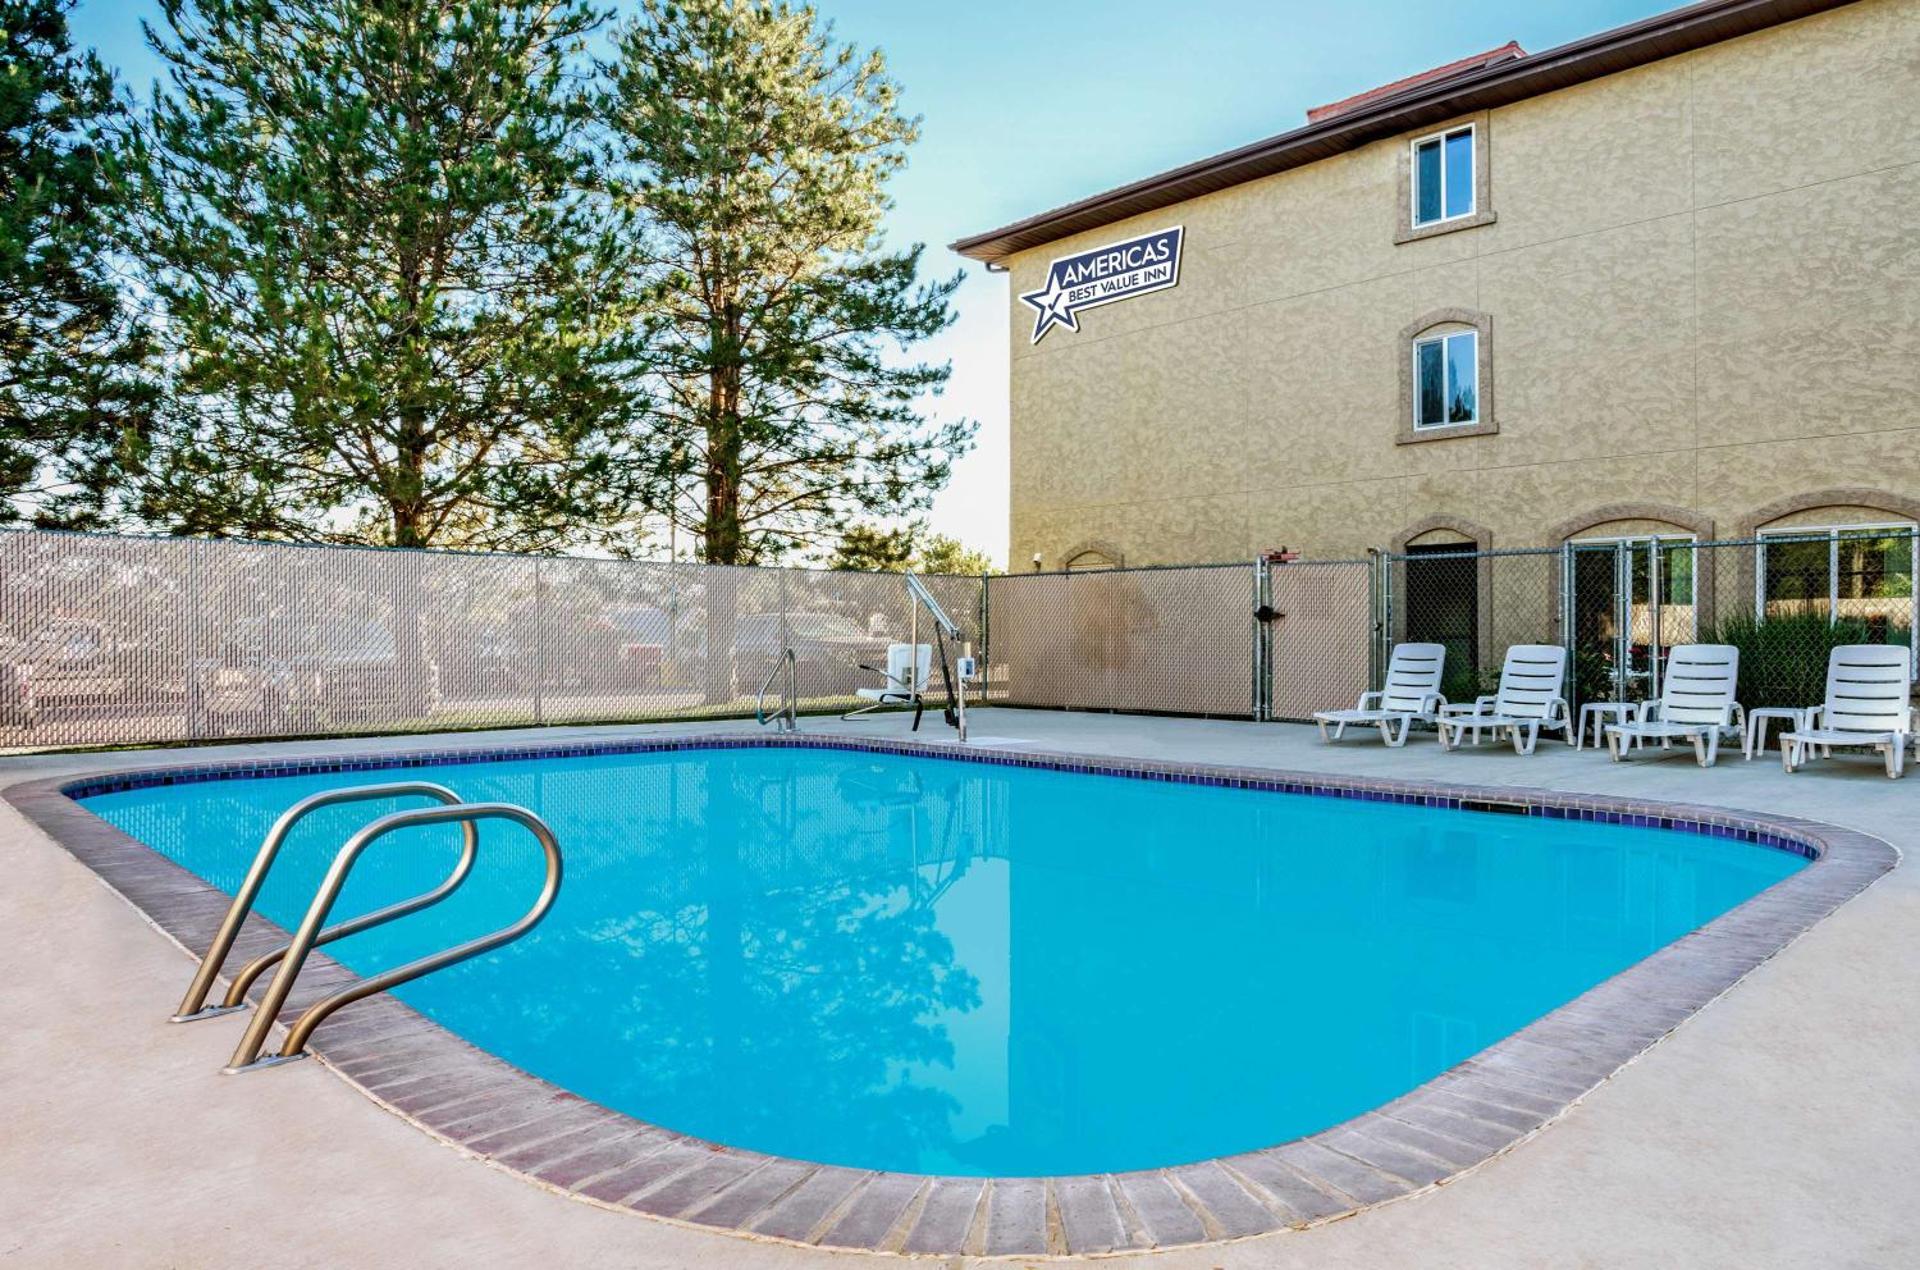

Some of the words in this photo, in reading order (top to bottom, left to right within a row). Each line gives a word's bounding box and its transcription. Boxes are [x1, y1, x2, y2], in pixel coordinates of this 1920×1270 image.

[1062, 239, 1169, 286] AMERICAS
[1069, 285, 1097, 302] BEST
[1101, 274, 1139, 293] VALUE
[1144, 266, 1167, 282] INN
